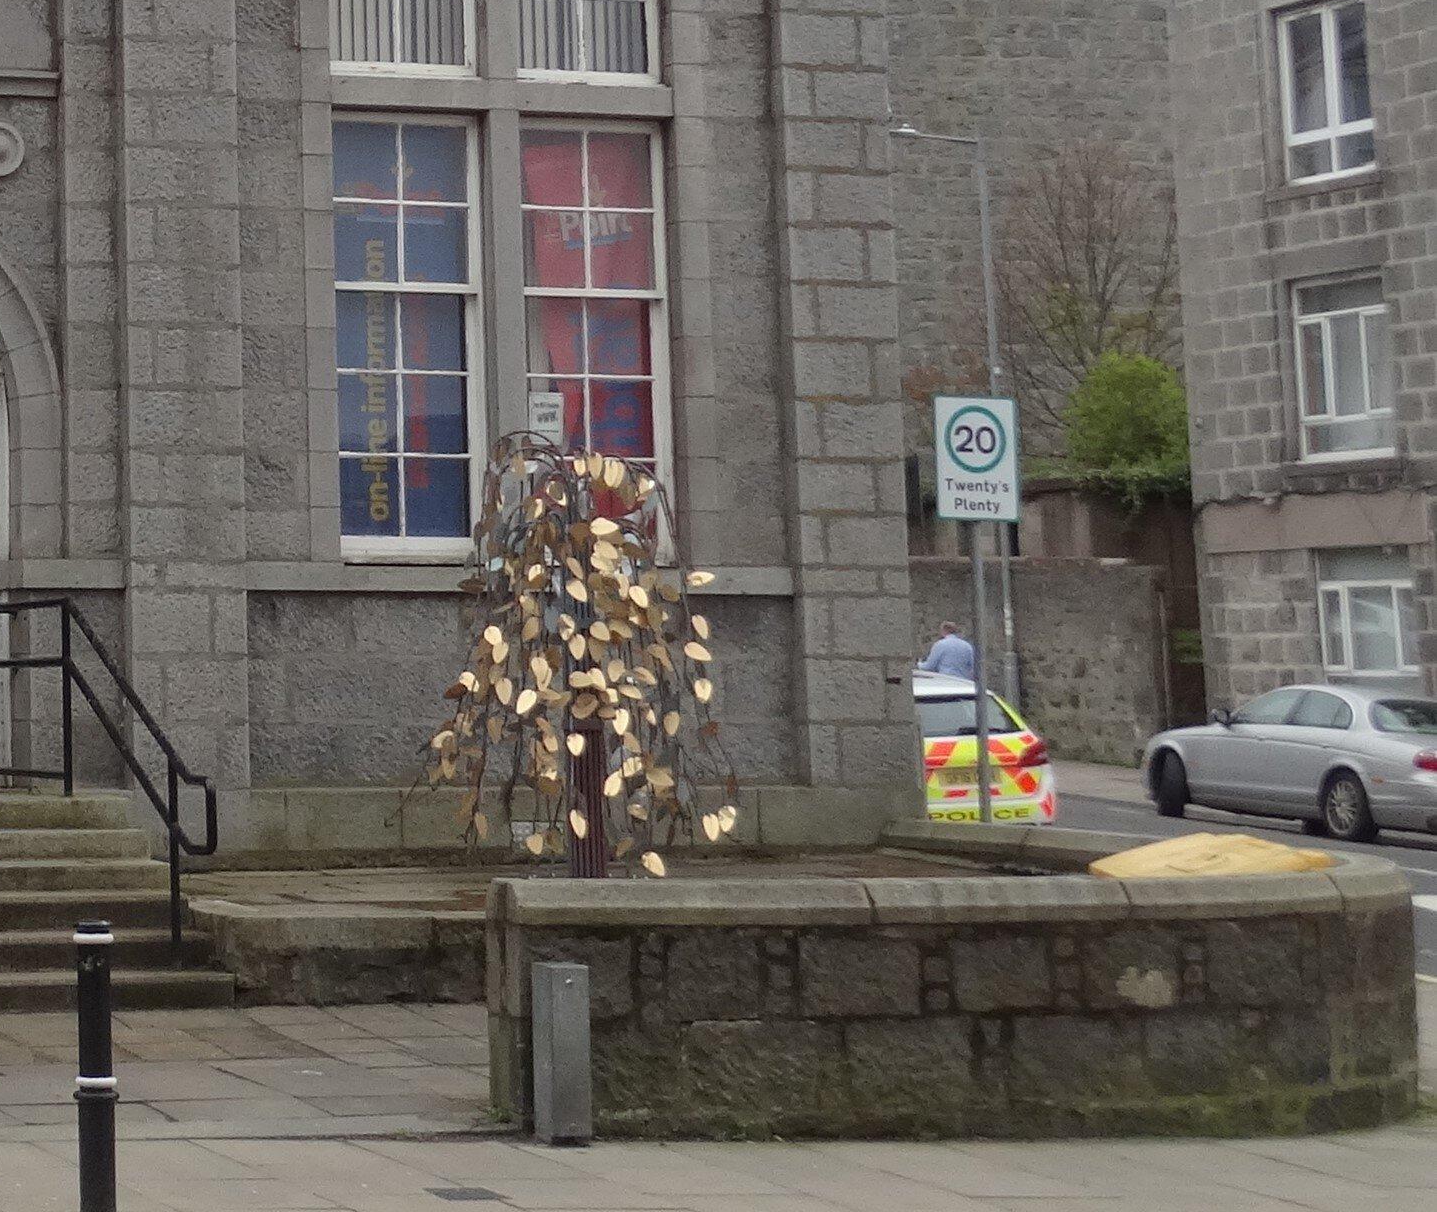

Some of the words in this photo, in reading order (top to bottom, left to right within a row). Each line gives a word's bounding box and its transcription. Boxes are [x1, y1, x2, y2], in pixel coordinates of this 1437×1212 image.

[954, 425, 996, 454] 20
[945, 478, 1009, 494] Twenty's
[954, 497, 1000, 514] Plenty
[928, 808, 1029, 821] POLCE
